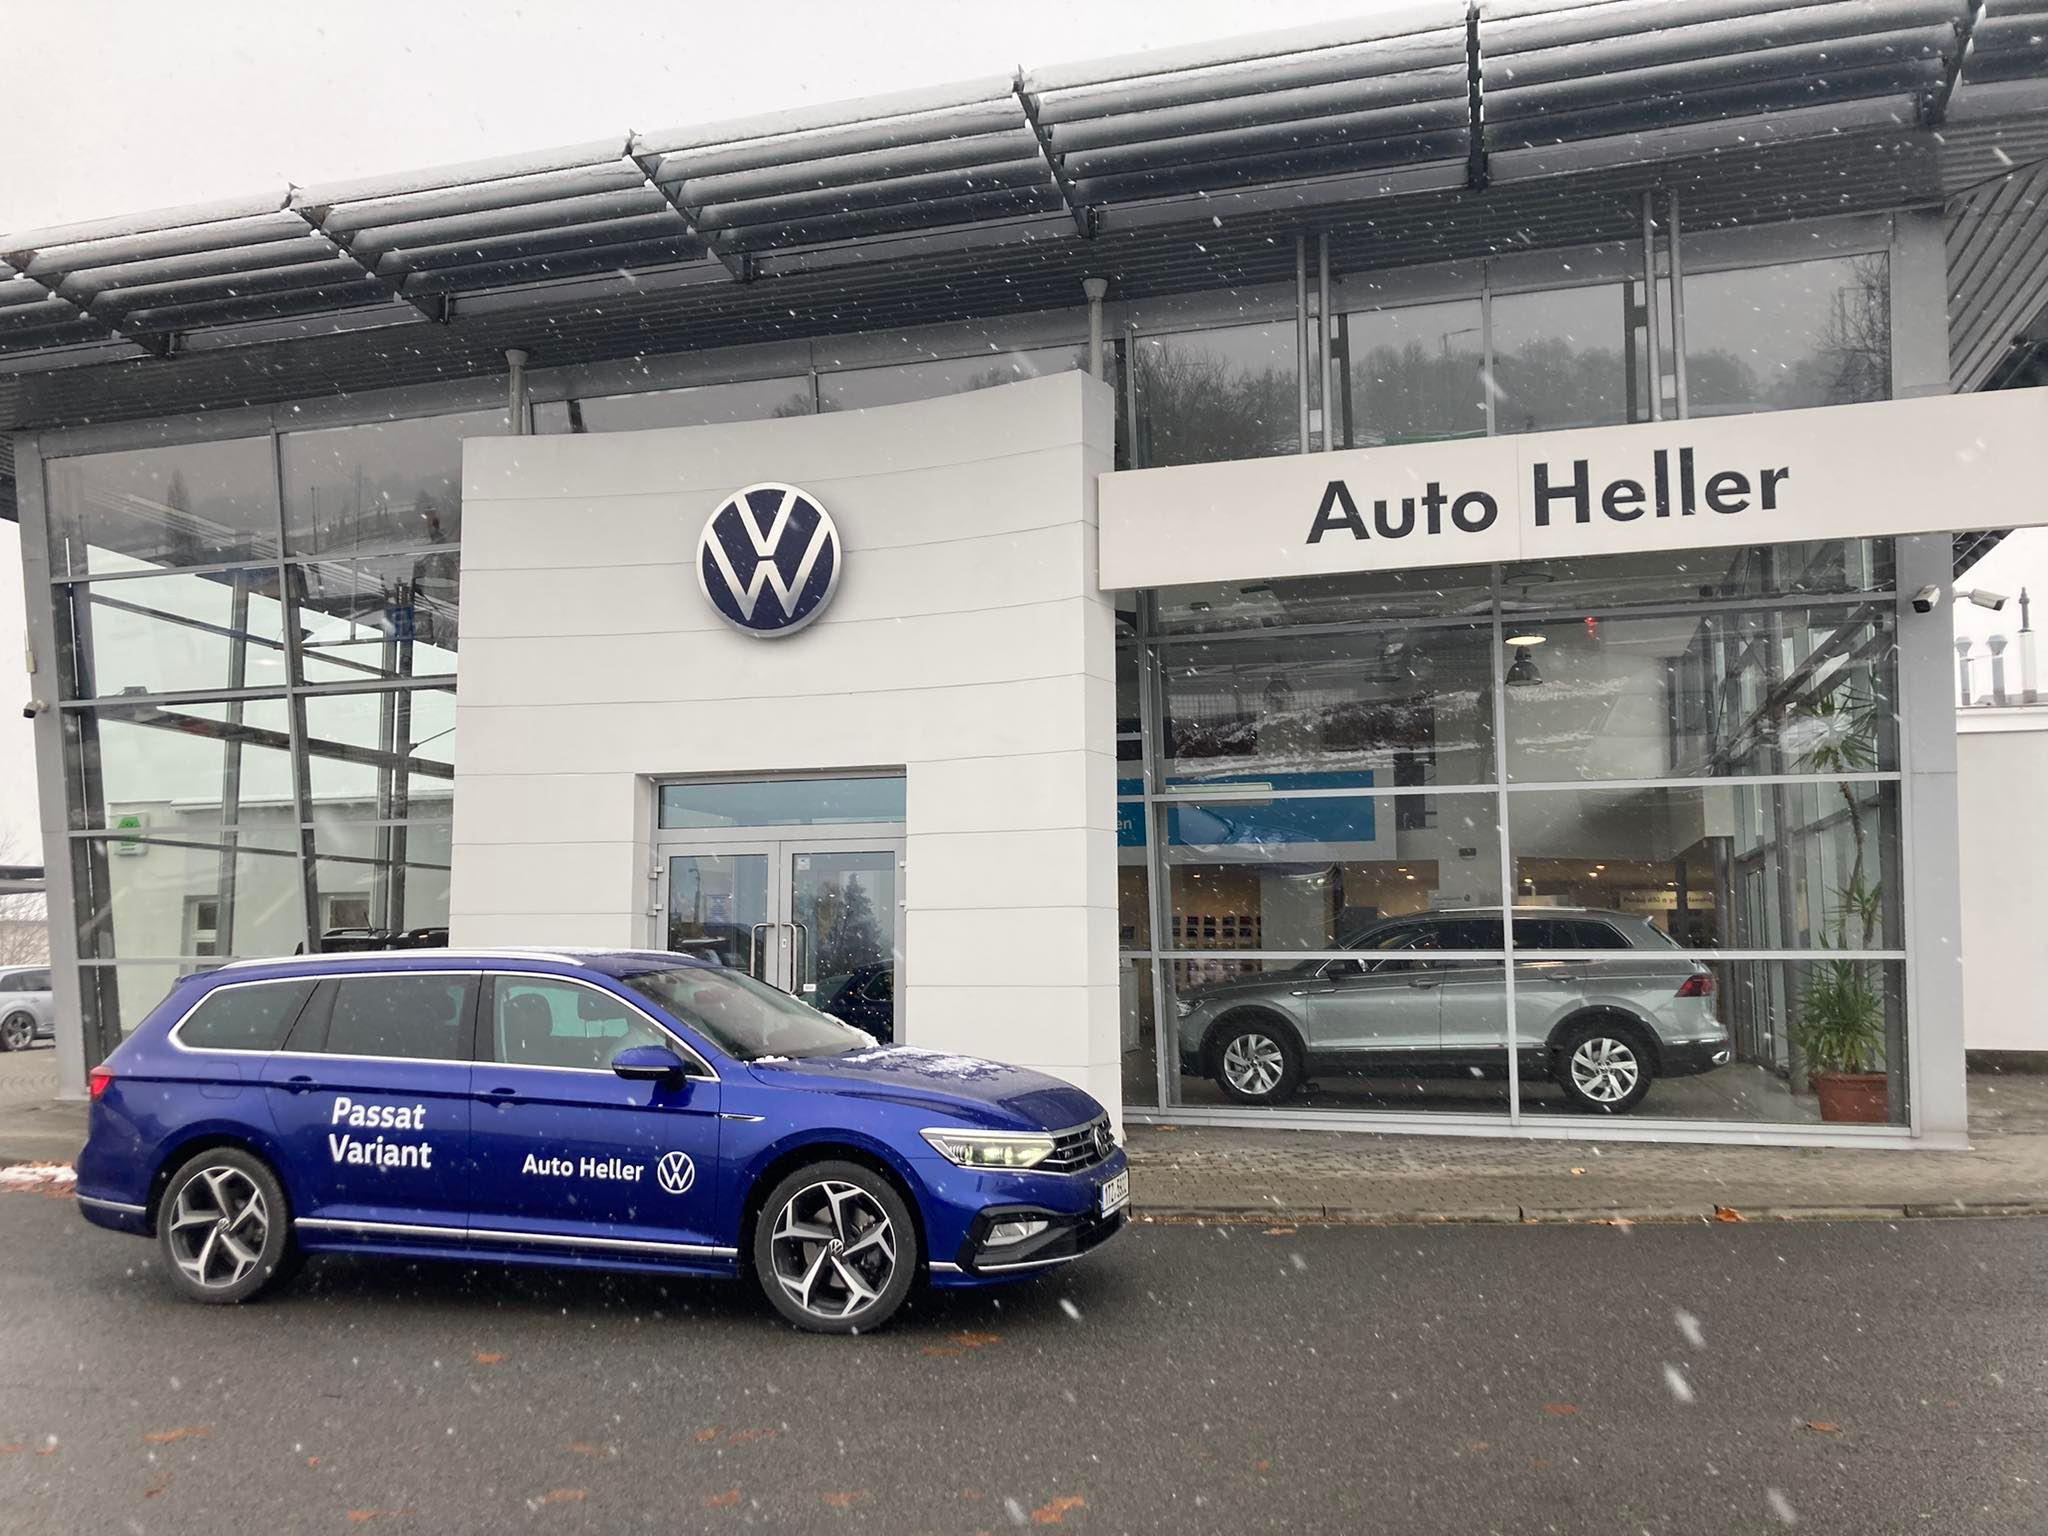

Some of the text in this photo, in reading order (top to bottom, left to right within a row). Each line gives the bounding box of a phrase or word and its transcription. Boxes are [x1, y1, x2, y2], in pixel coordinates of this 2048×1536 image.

[1305, 447, 1789, 544] Auto Heller
[331, 1096, 427, 1130] Passat
[328, 1133, 433, 1169] Variant
[522, 1153, 645, 1183] Auto Heller
